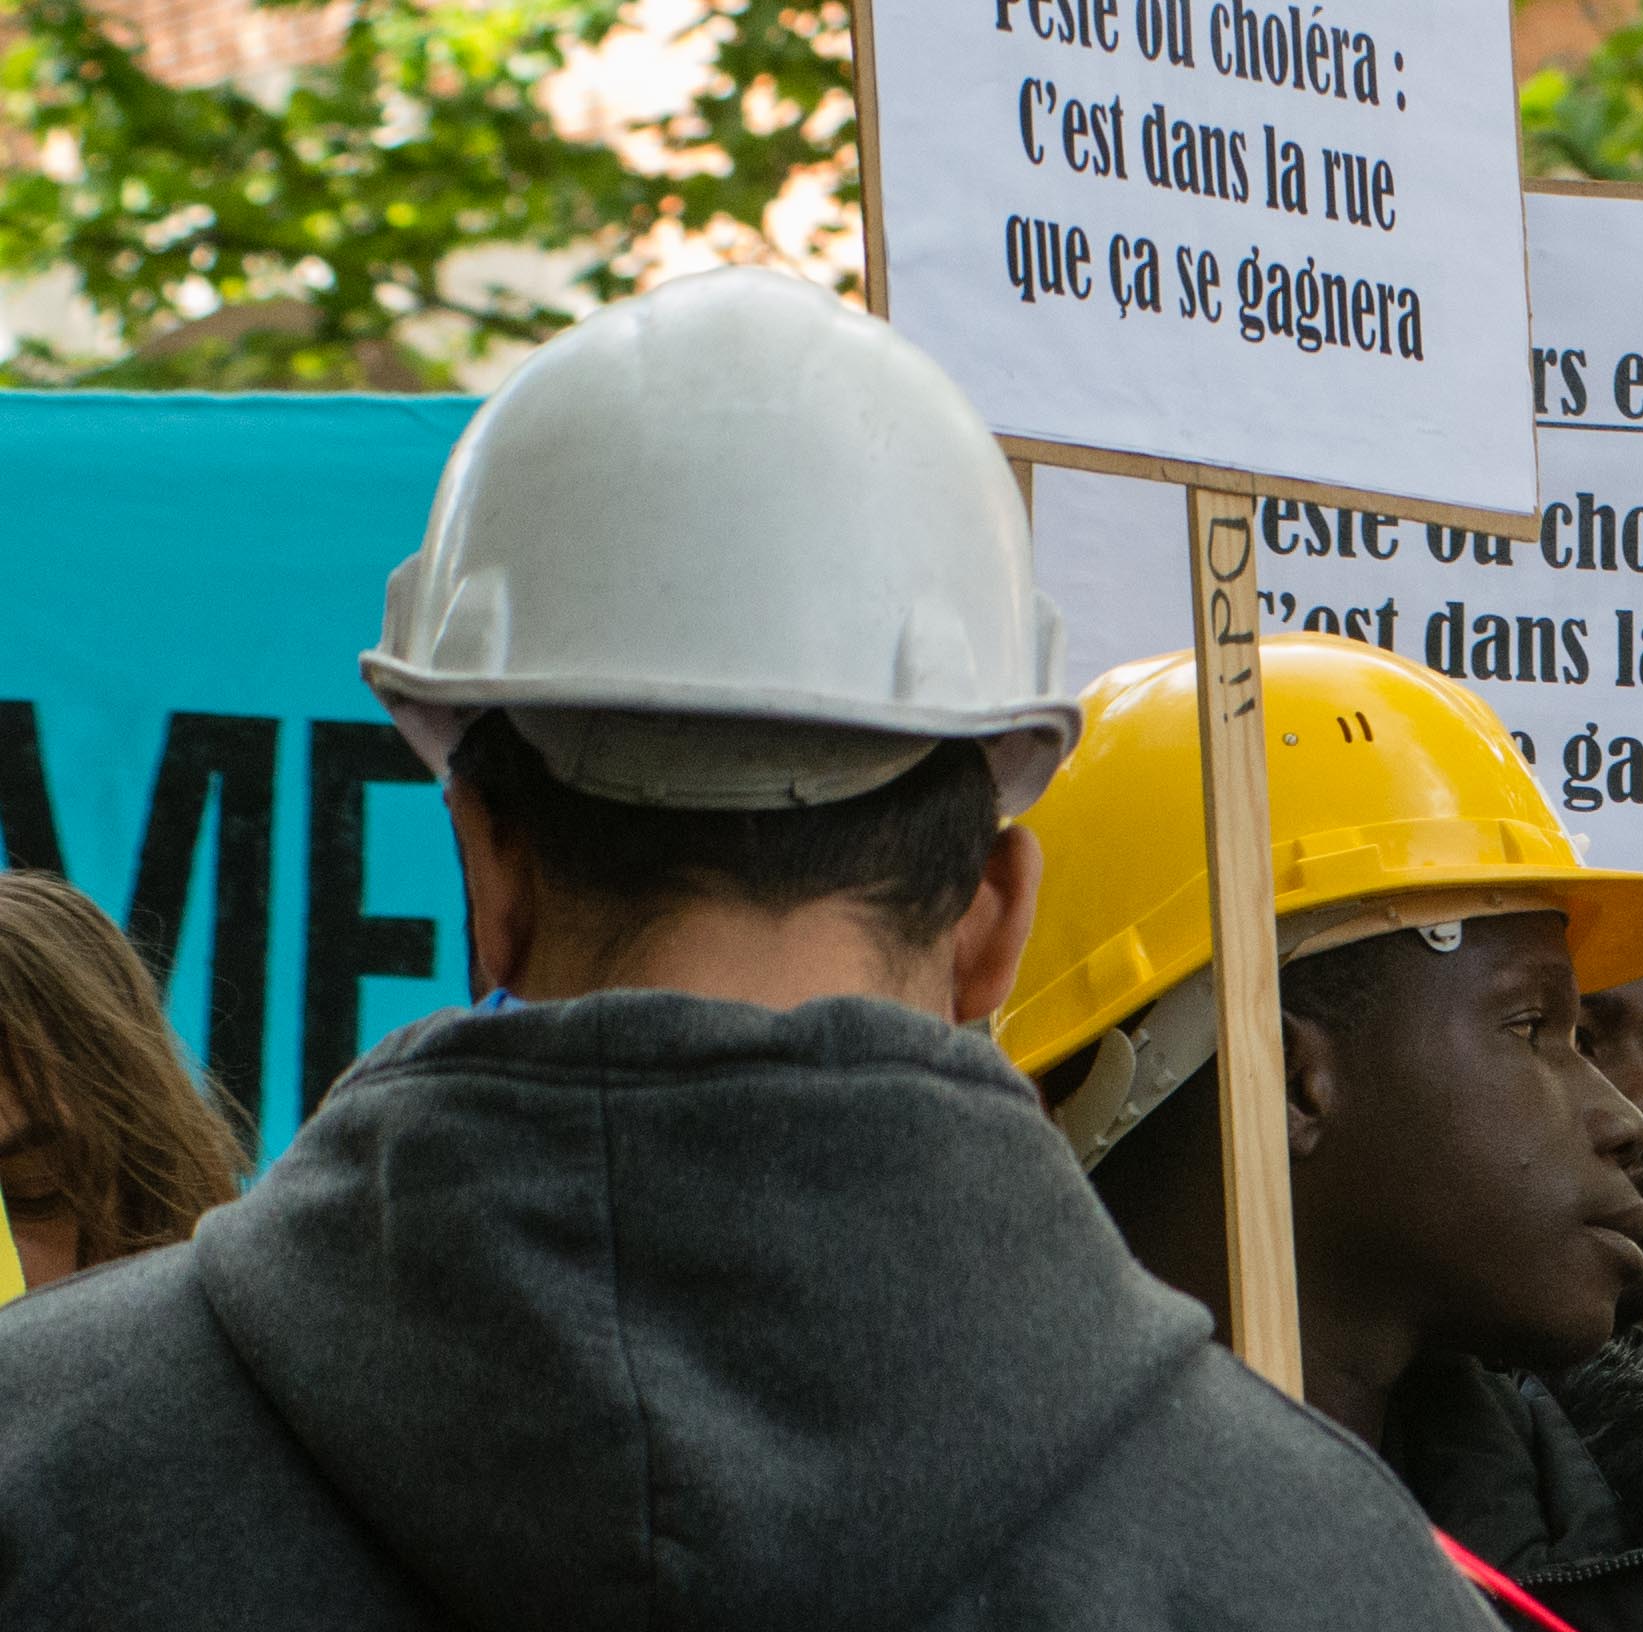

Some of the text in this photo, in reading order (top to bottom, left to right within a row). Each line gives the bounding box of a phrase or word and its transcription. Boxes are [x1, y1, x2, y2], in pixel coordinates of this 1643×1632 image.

[1136, 0, 1195, 69] ou
[1211, 0, 1380, 105] choléra
[1143, 104, 1249, 204] dans
[1264, 125, 1308, 216] la
[1322, 149, 1396, 231] rue
[1006, 214, 1424, 361] que ça se gagnera
[1425, 601, 1590, 685] dans
